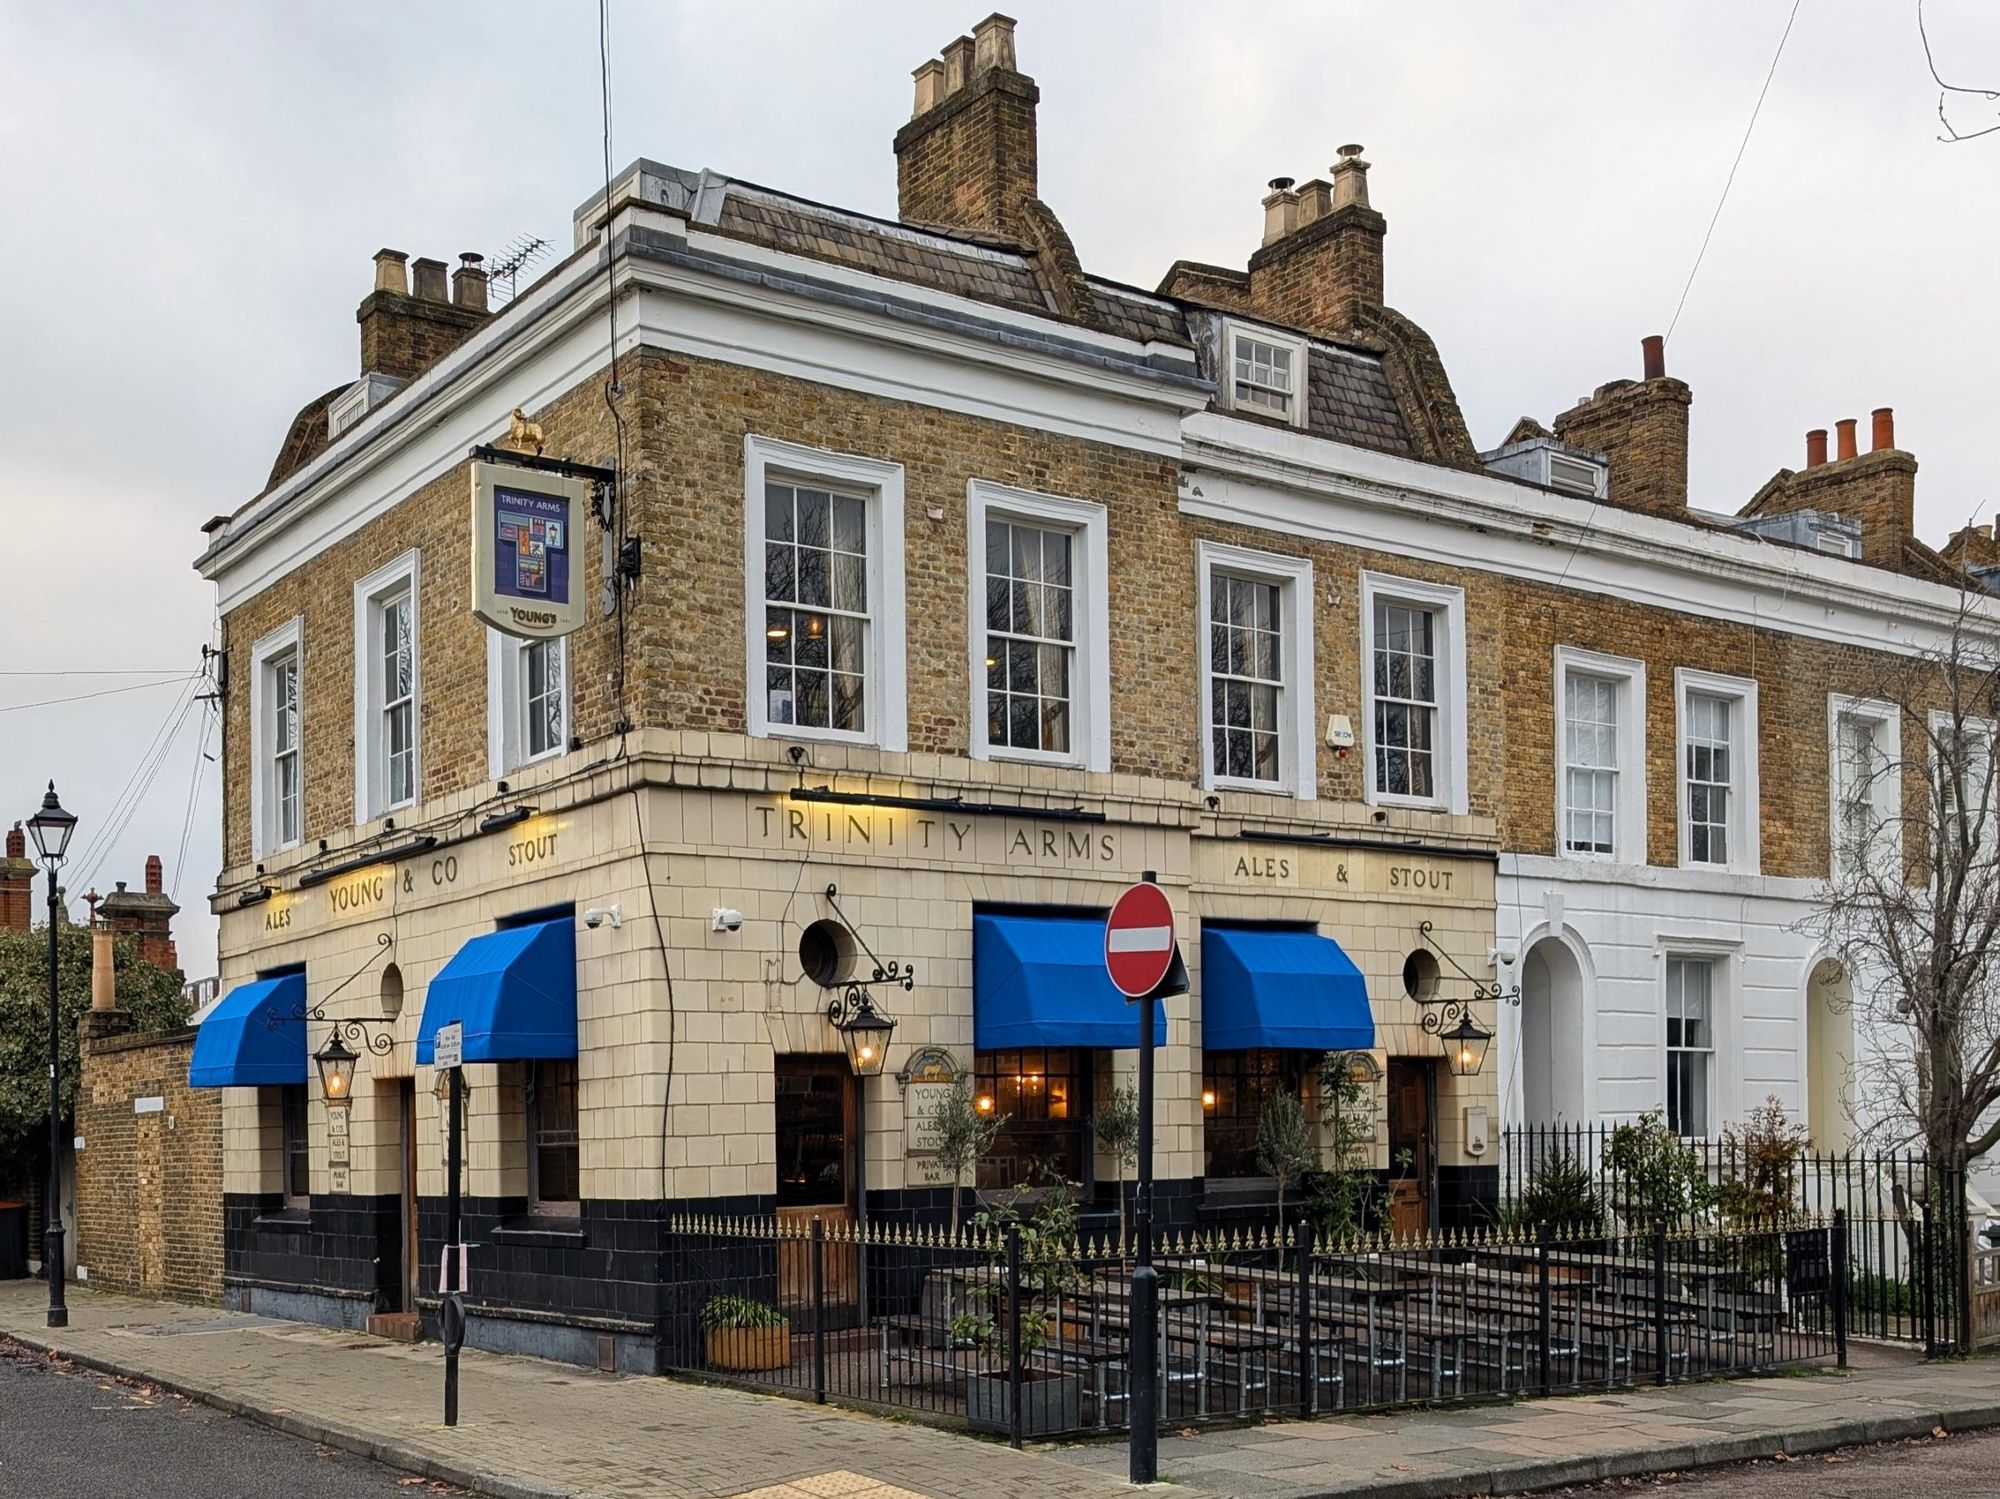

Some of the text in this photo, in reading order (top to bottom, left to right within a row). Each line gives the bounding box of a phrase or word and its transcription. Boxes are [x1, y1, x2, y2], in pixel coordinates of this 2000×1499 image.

[501, 494, 561, 513] TRINITY ARMS
[510, 606, 557, 625] YOUNG'S
[755, 806, 1115, 861] TRINITY ARMS
[265, 832, 558, 931] ALES YOUNG & CO STOUT
[1234, 855, 1453, 891] ALES & STOUT
[915, 1087, 951, 1100] YOUNG
[917, 1105, 925, 1116] &
[924, 1172, 941, 1181] BAR
